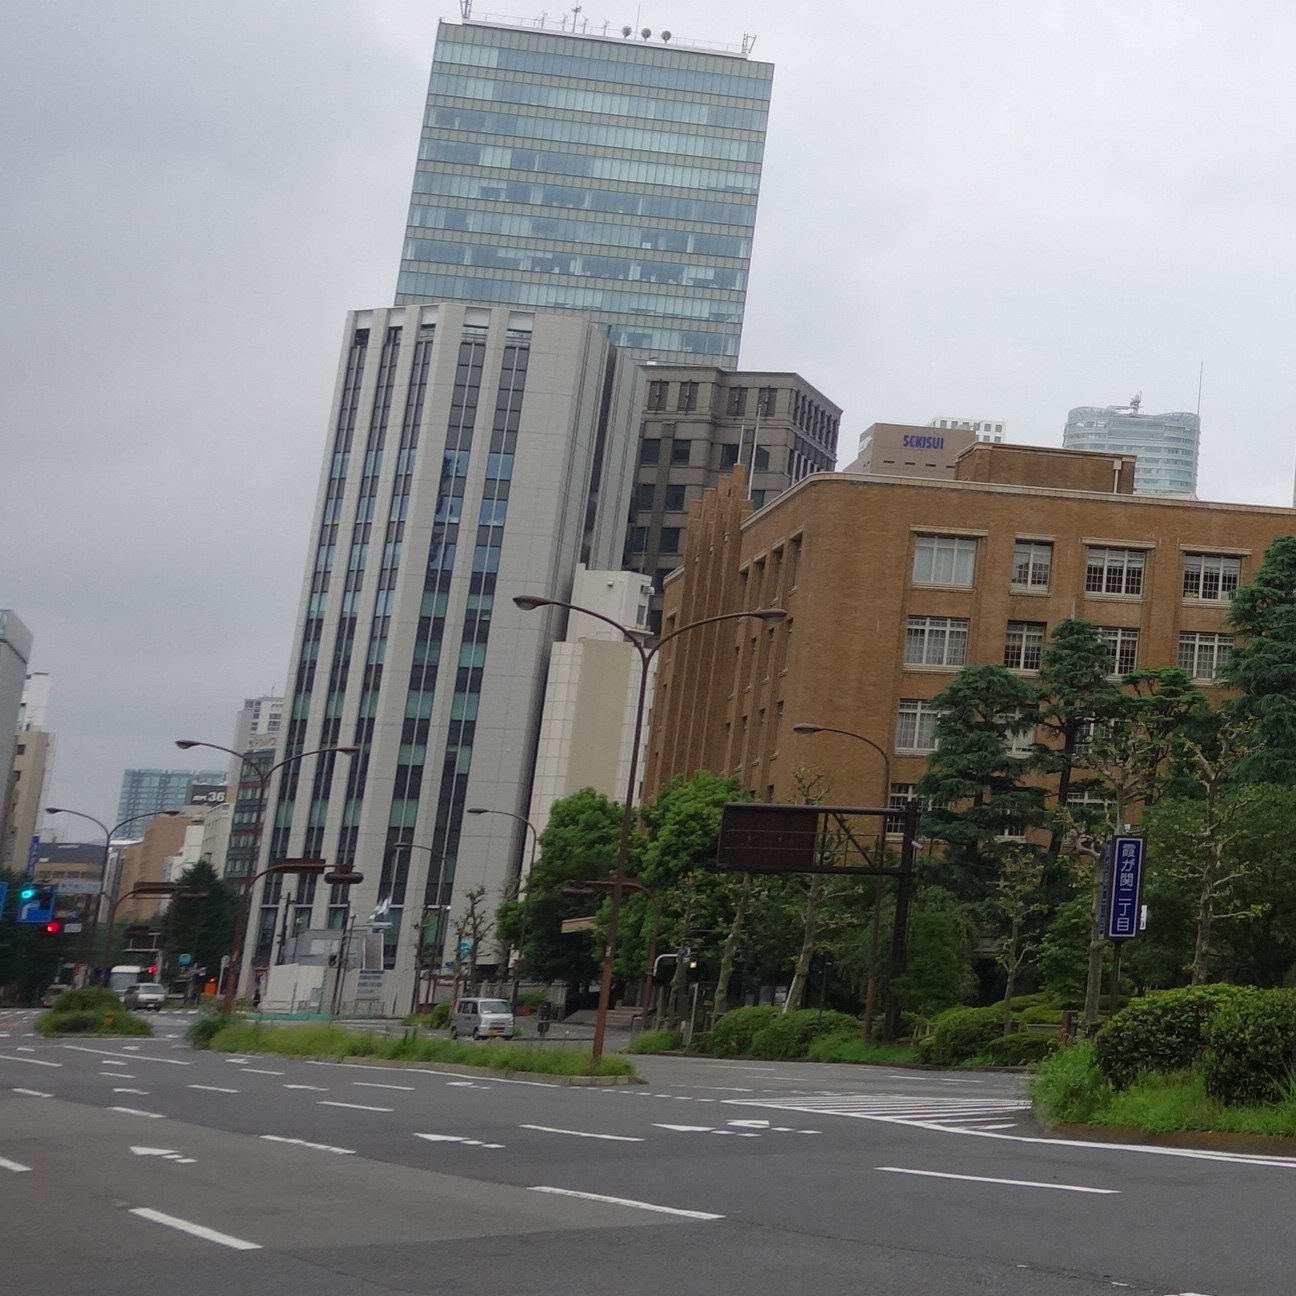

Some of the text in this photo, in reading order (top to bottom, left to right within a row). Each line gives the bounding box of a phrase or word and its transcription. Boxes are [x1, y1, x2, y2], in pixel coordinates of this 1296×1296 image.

[903, 435, 944, 449] SEKISUI
[1116, 844, 1136, 931] 霞が関二丁目
